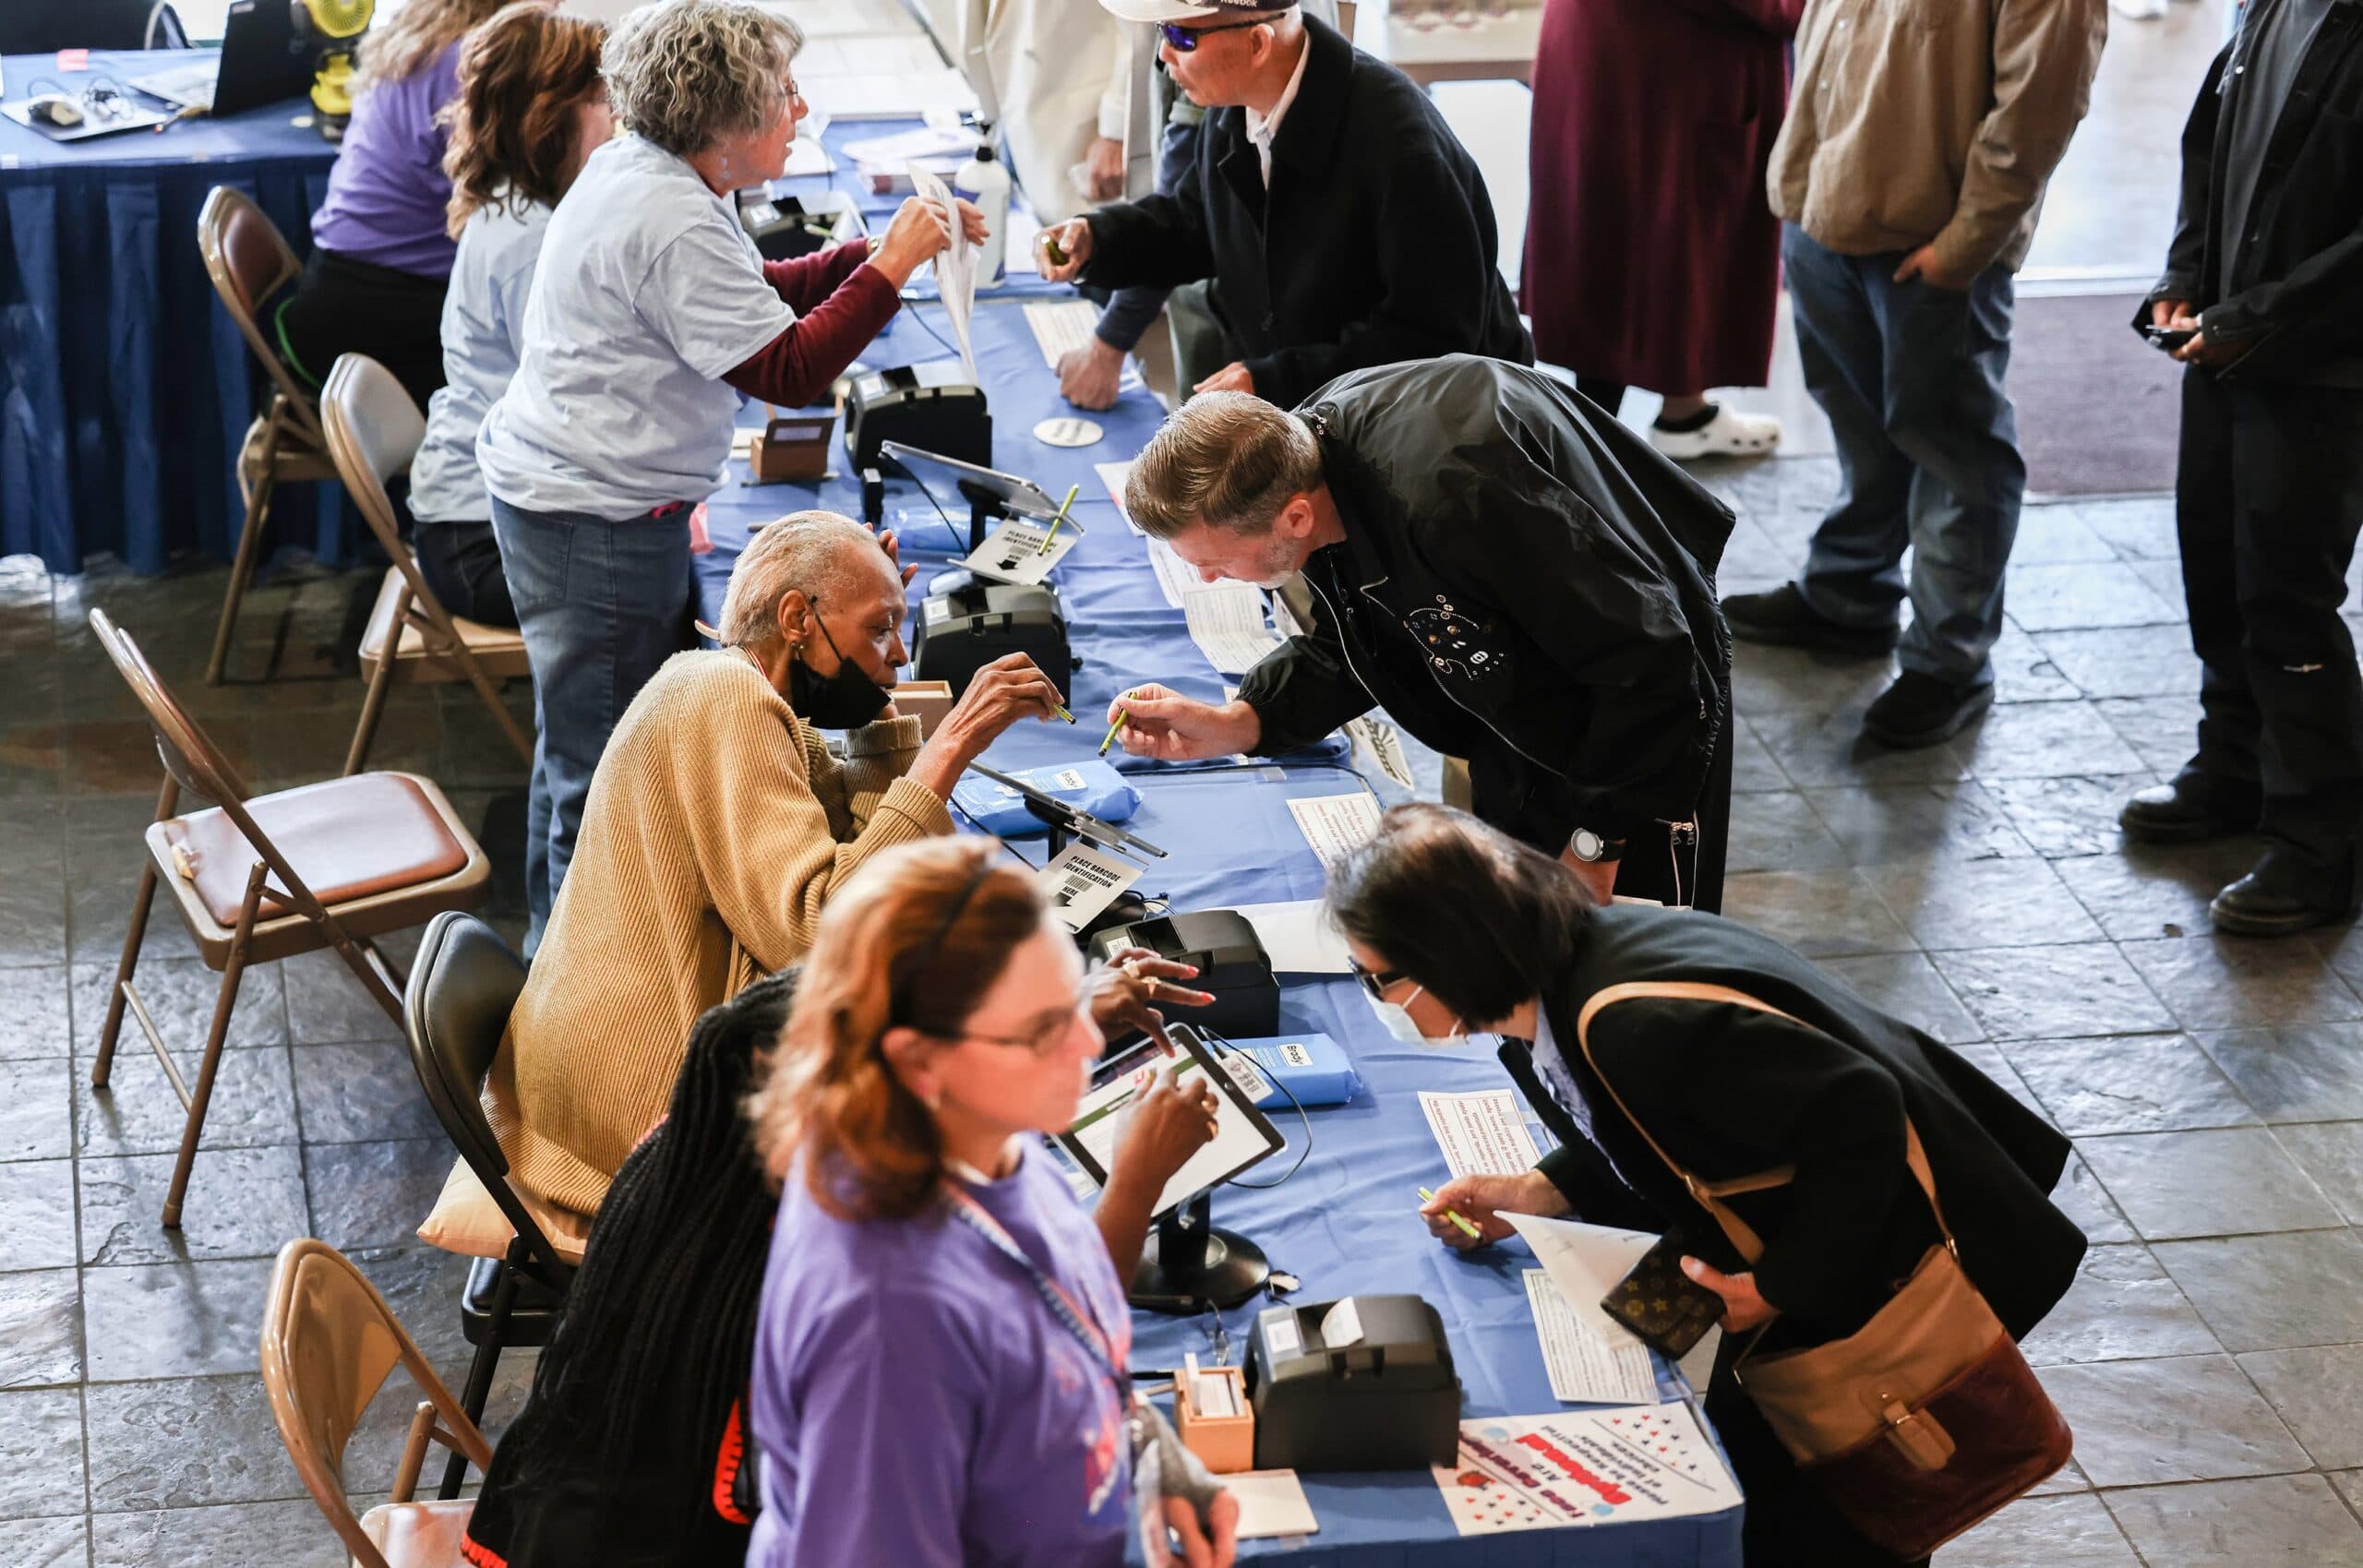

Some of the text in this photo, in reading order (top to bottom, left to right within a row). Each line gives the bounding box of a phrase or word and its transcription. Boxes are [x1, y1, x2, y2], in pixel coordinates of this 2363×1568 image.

[1063, 862, 1113, 889] IDENTIFICATION
[1071, 856, 1122, 881] PLACE BARCODE
[1062, 885, 1079, 896] HERE
[1515, 1433, 1632, 1504] Optional
[1531, 1464, 1561, 1480] Are
[1609, 1470, 1625, 1479] be
[1626, 1480, 1669, 1504] Please
[1644, 1478, 1661, 1488] of
